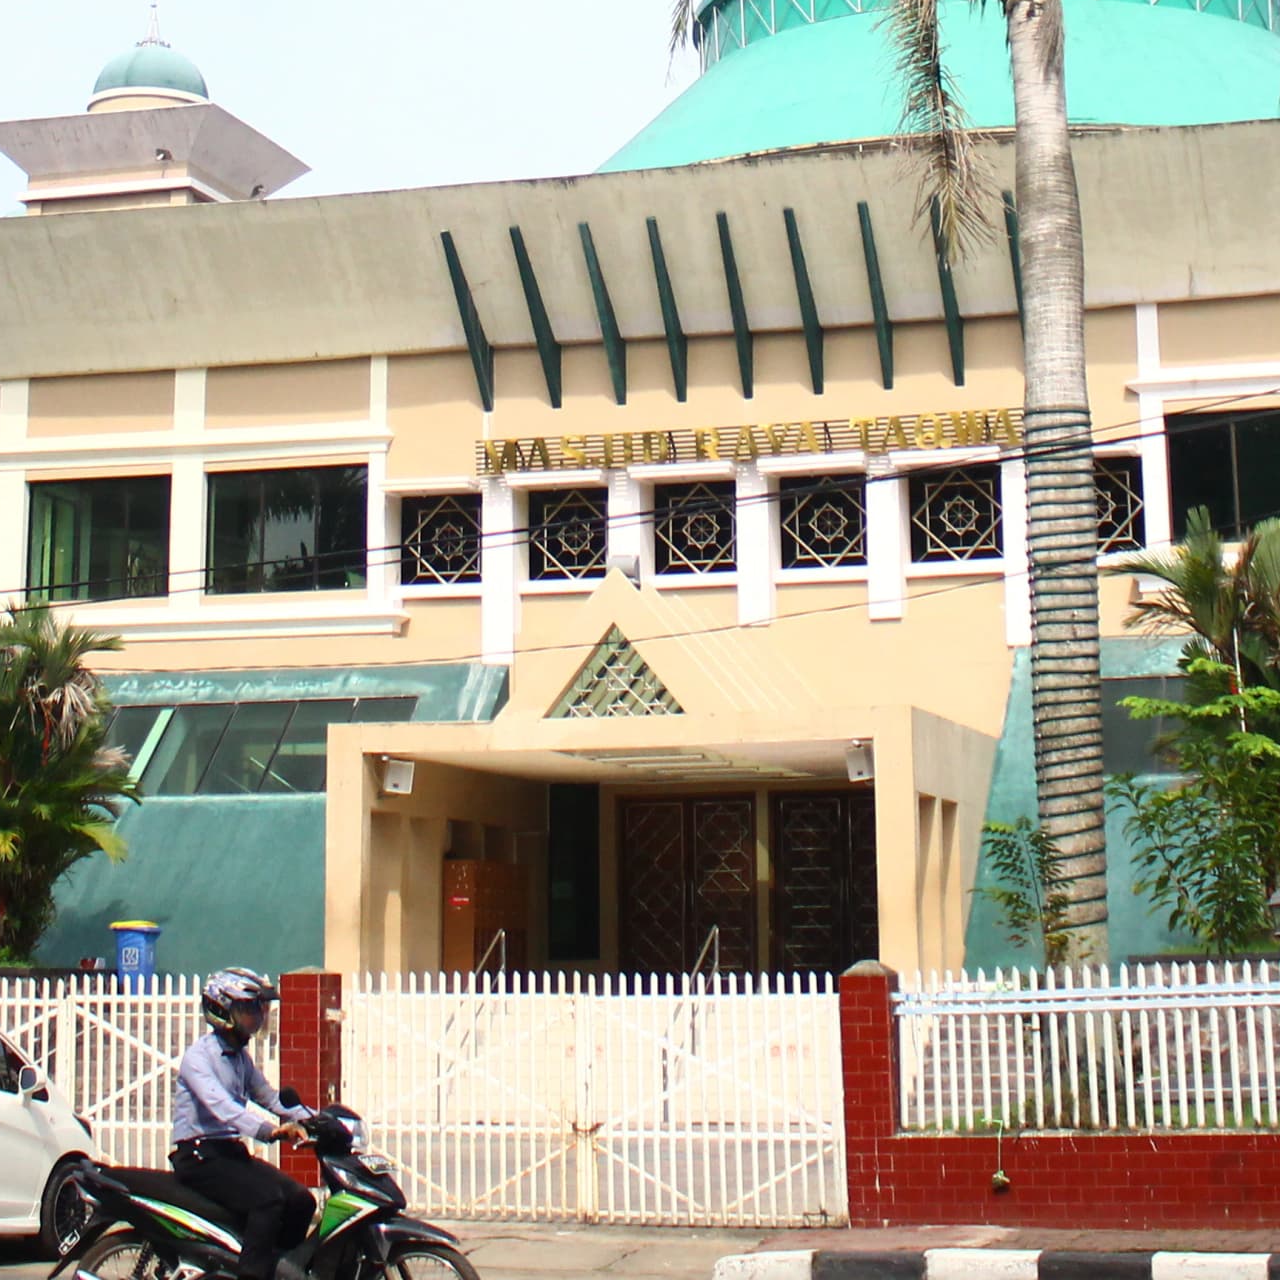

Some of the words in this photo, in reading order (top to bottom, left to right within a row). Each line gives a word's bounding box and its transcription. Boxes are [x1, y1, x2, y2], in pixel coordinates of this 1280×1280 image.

[484, 430, 669, 473] MASJID
[696, 421, 821, 462] RAYA
[849, 408, 1021, 454] TAQWA
